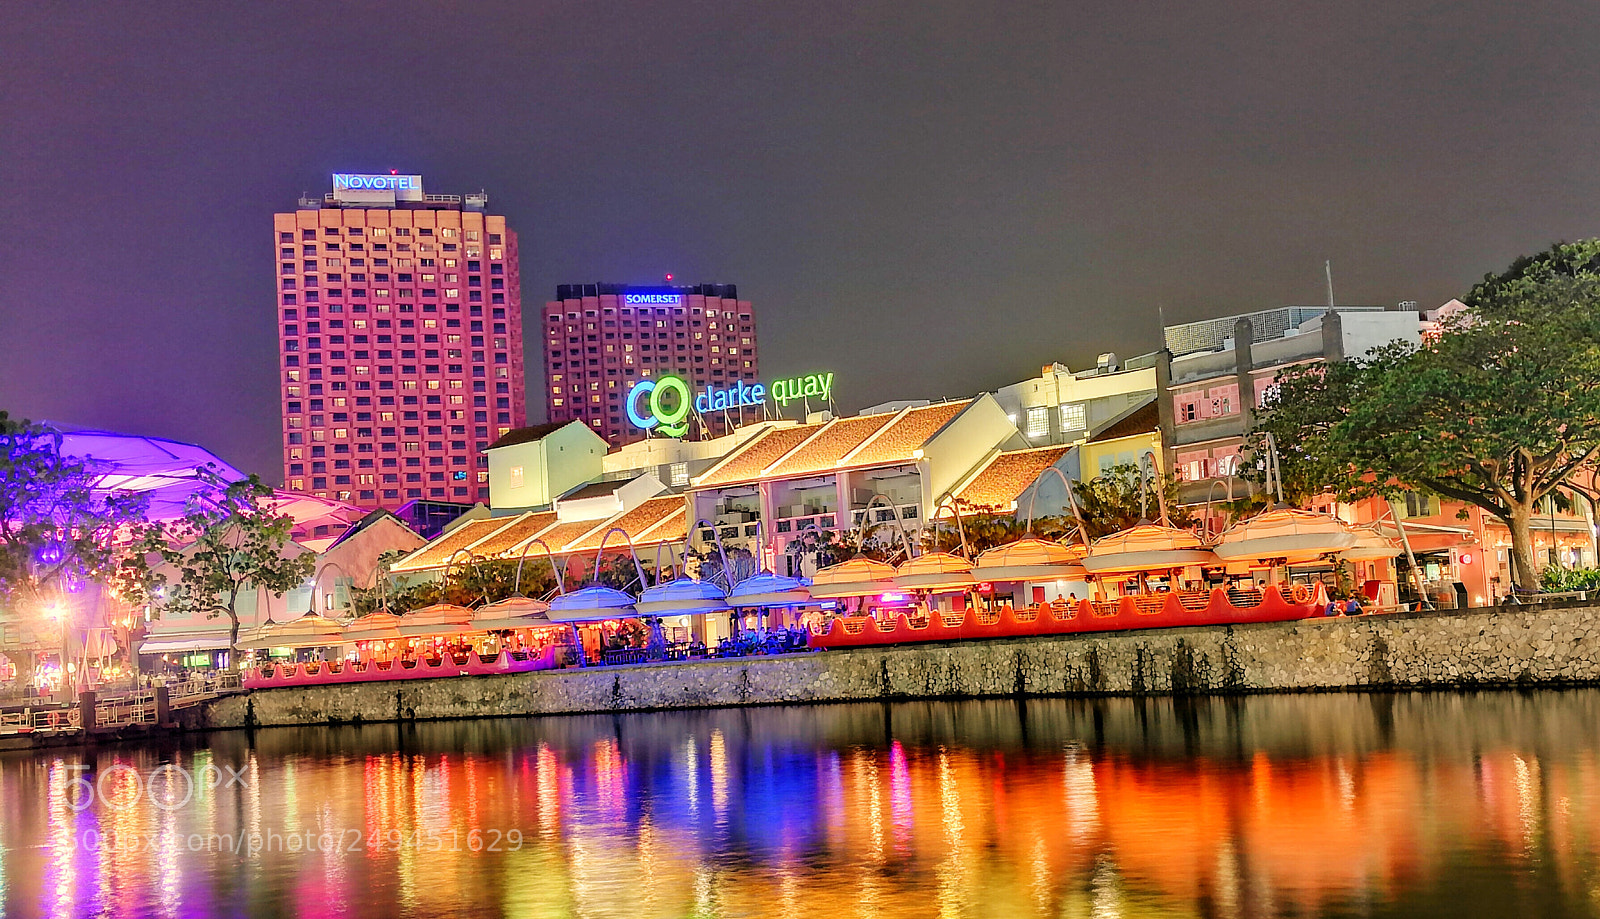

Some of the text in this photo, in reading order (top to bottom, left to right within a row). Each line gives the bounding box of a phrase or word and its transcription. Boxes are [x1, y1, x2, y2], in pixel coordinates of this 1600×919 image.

[335, 174, 419, 190] NOVOTEL
[626, 294, 680, 304] SOMERSET
[695, 380, 766, 414] clarke
[771, 372, 834, 407] quay
